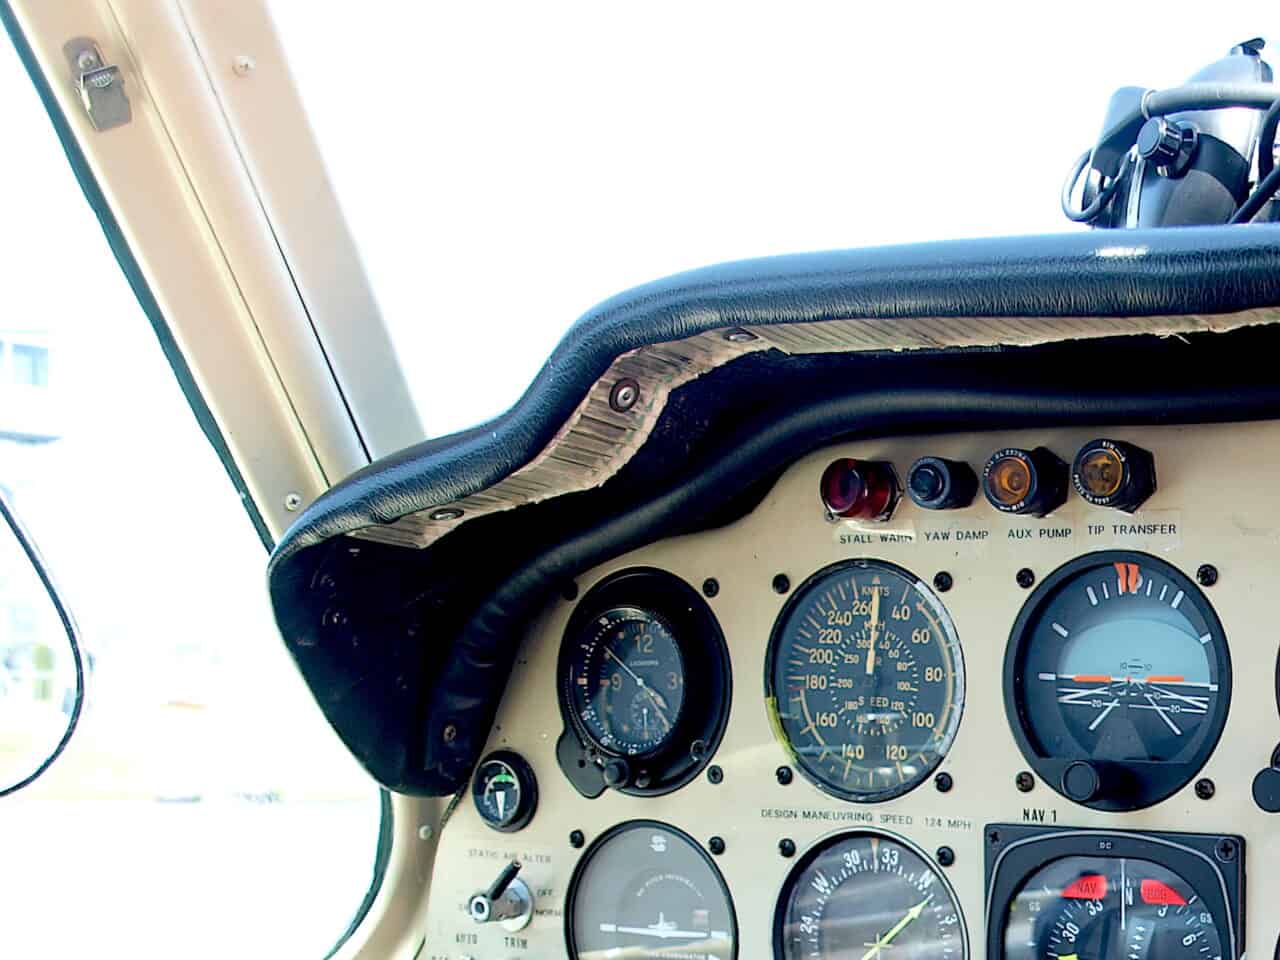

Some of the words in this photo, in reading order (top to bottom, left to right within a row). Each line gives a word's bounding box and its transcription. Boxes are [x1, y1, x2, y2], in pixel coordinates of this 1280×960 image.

[924, 532, 950, 540] YAW
[956, 530, 988, 540] DAMP
[1008, 528, 1031, 539] AUX
[1039, 527, 1072, 538] PUMP
[1088, 525, 1104, 535] TIP
[1111, 524, 1176, 535] TRANSFER
[840, 534, 872, 544] STALL
[828, 612, 851, 625] 240
[892, 607, 910, 620] 40
[819, 629, 841, 643] 220
[912, 629, 930, 643] 60
[635, 635, 653, 653] 12
[810, 650, 832, 663] 200
[806, 676, 827, 689] 180
[816, 713, 837, 726] 160
[912, 713, 934, 727] 100
[761, 809, 797, 819] DESIGN
[880, 815, 913, 824] SPEED
[948, 819, 971, 828] MPH
[1023, 808, 1045, 822] NAV
